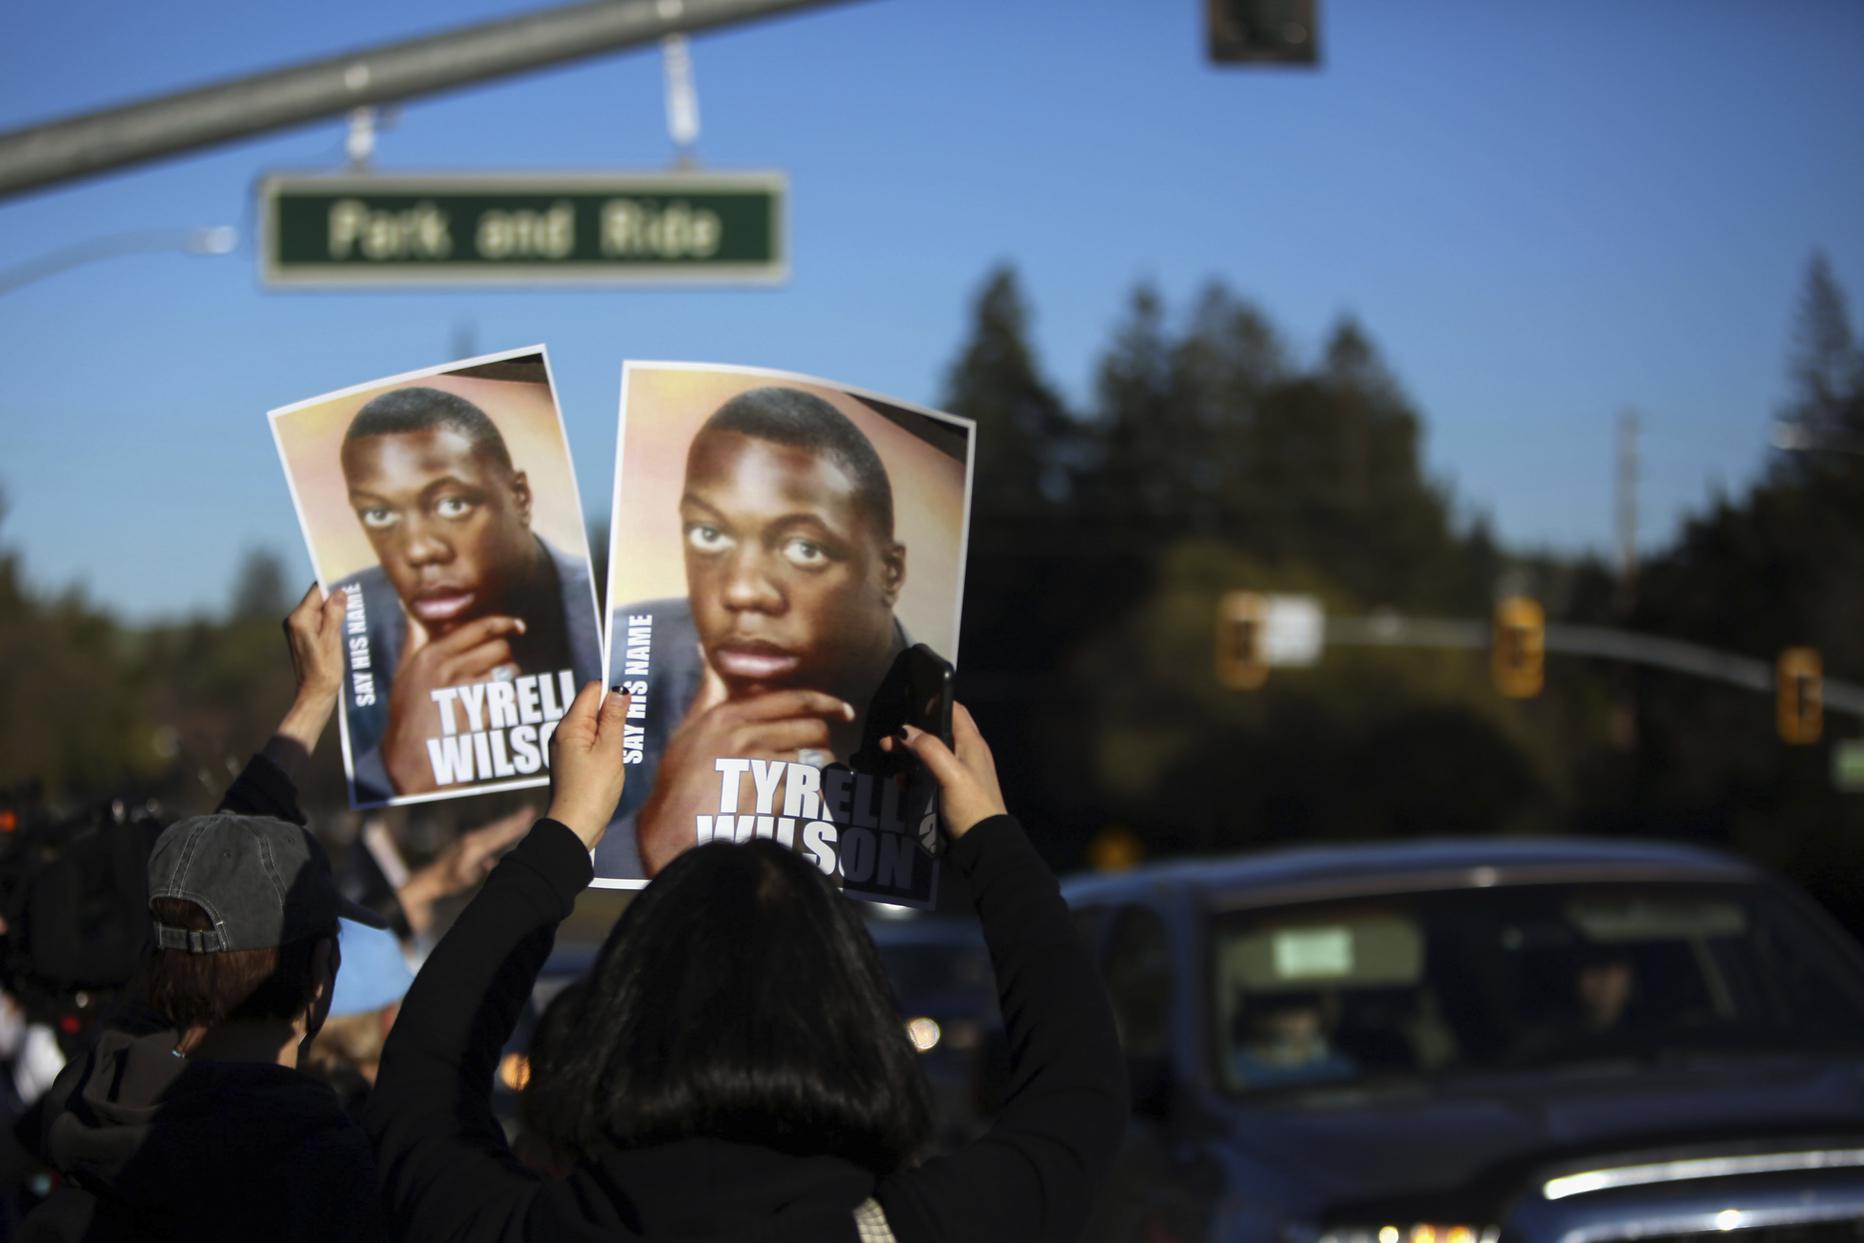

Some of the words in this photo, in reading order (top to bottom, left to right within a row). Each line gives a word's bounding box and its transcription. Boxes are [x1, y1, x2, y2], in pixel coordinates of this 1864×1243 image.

[329, 200, 453, 258] Park
[477, 201, 576, 258] and
[601, 200, 722, 258] Ride
[346, 582, 367, 635] NAME
[349, 636, 370, 670] HIS
[624, 614, 653, 675] NAME
[352, 672, 375, 707] SAY
[624, 680, 649, 718] HIS
[426, 720, 560, 786] WILS
[623, 724, 645, 764] SAY
